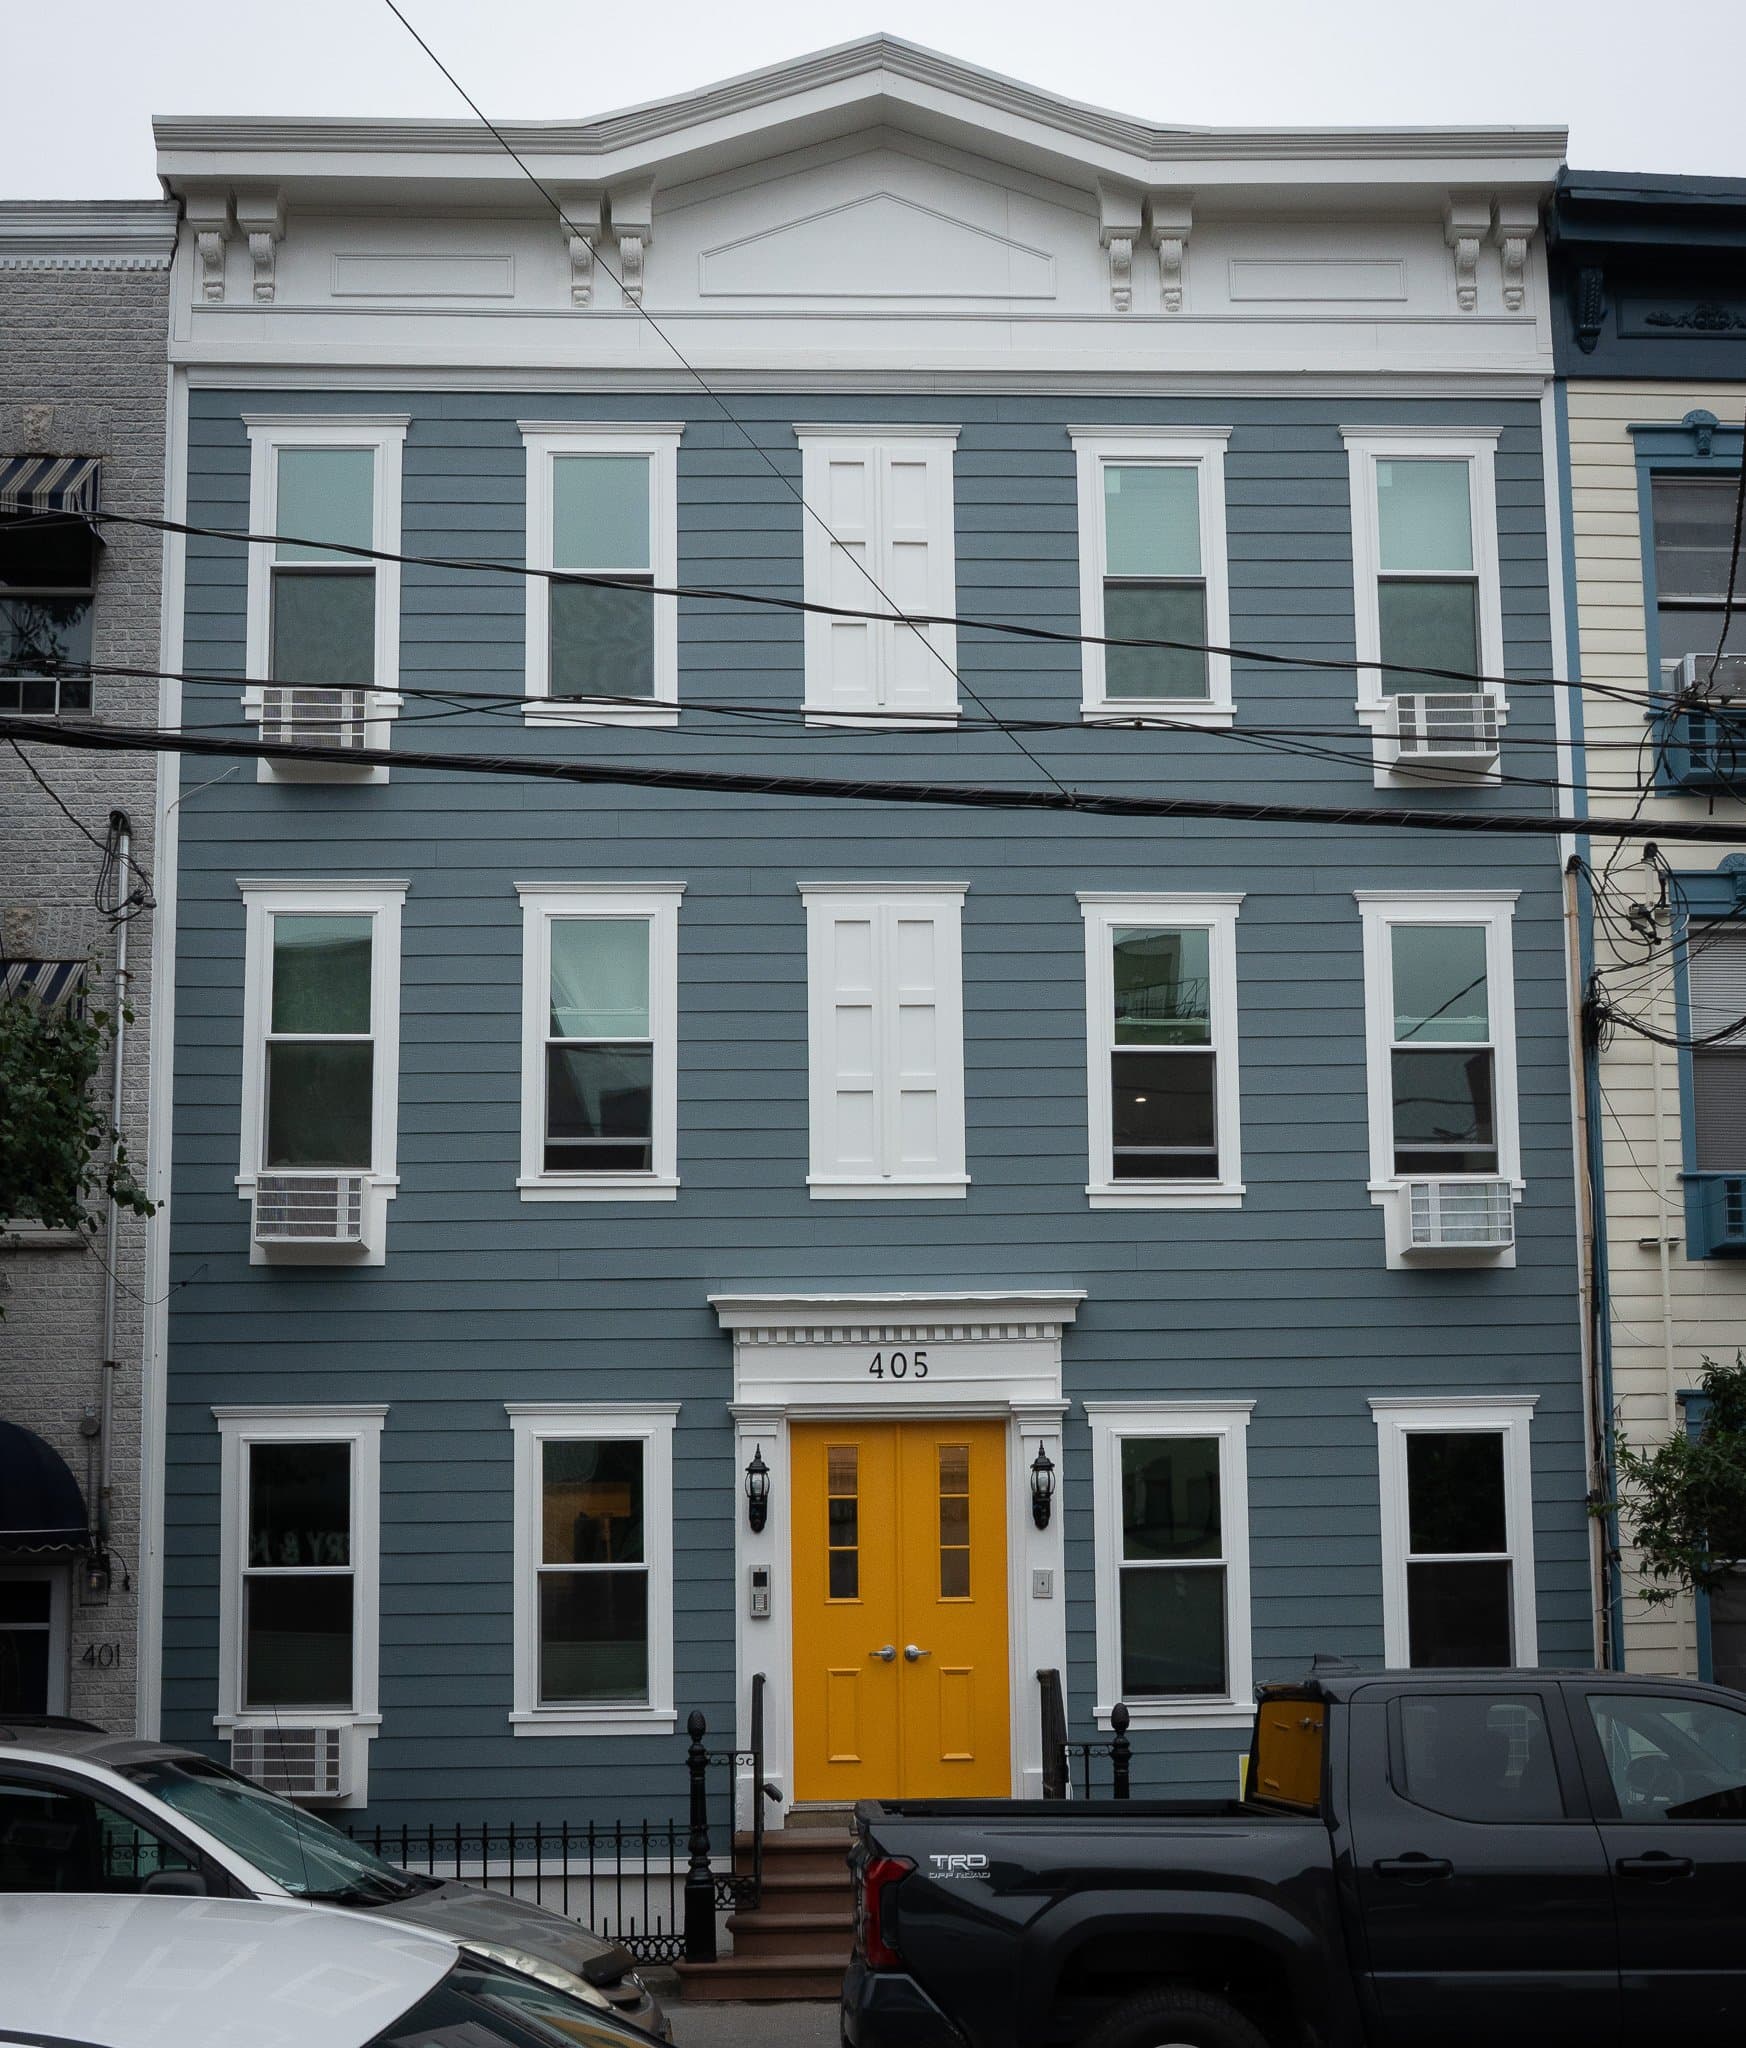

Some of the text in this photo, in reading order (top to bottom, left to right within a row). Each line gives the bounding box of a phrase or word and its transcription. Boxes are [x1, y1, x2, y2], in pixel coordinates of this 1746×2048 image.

[869, 1351, 929, 1379] 405
[82, 1643, 120, 1667] 401
[929, 1854, 988, 1871] TRD
